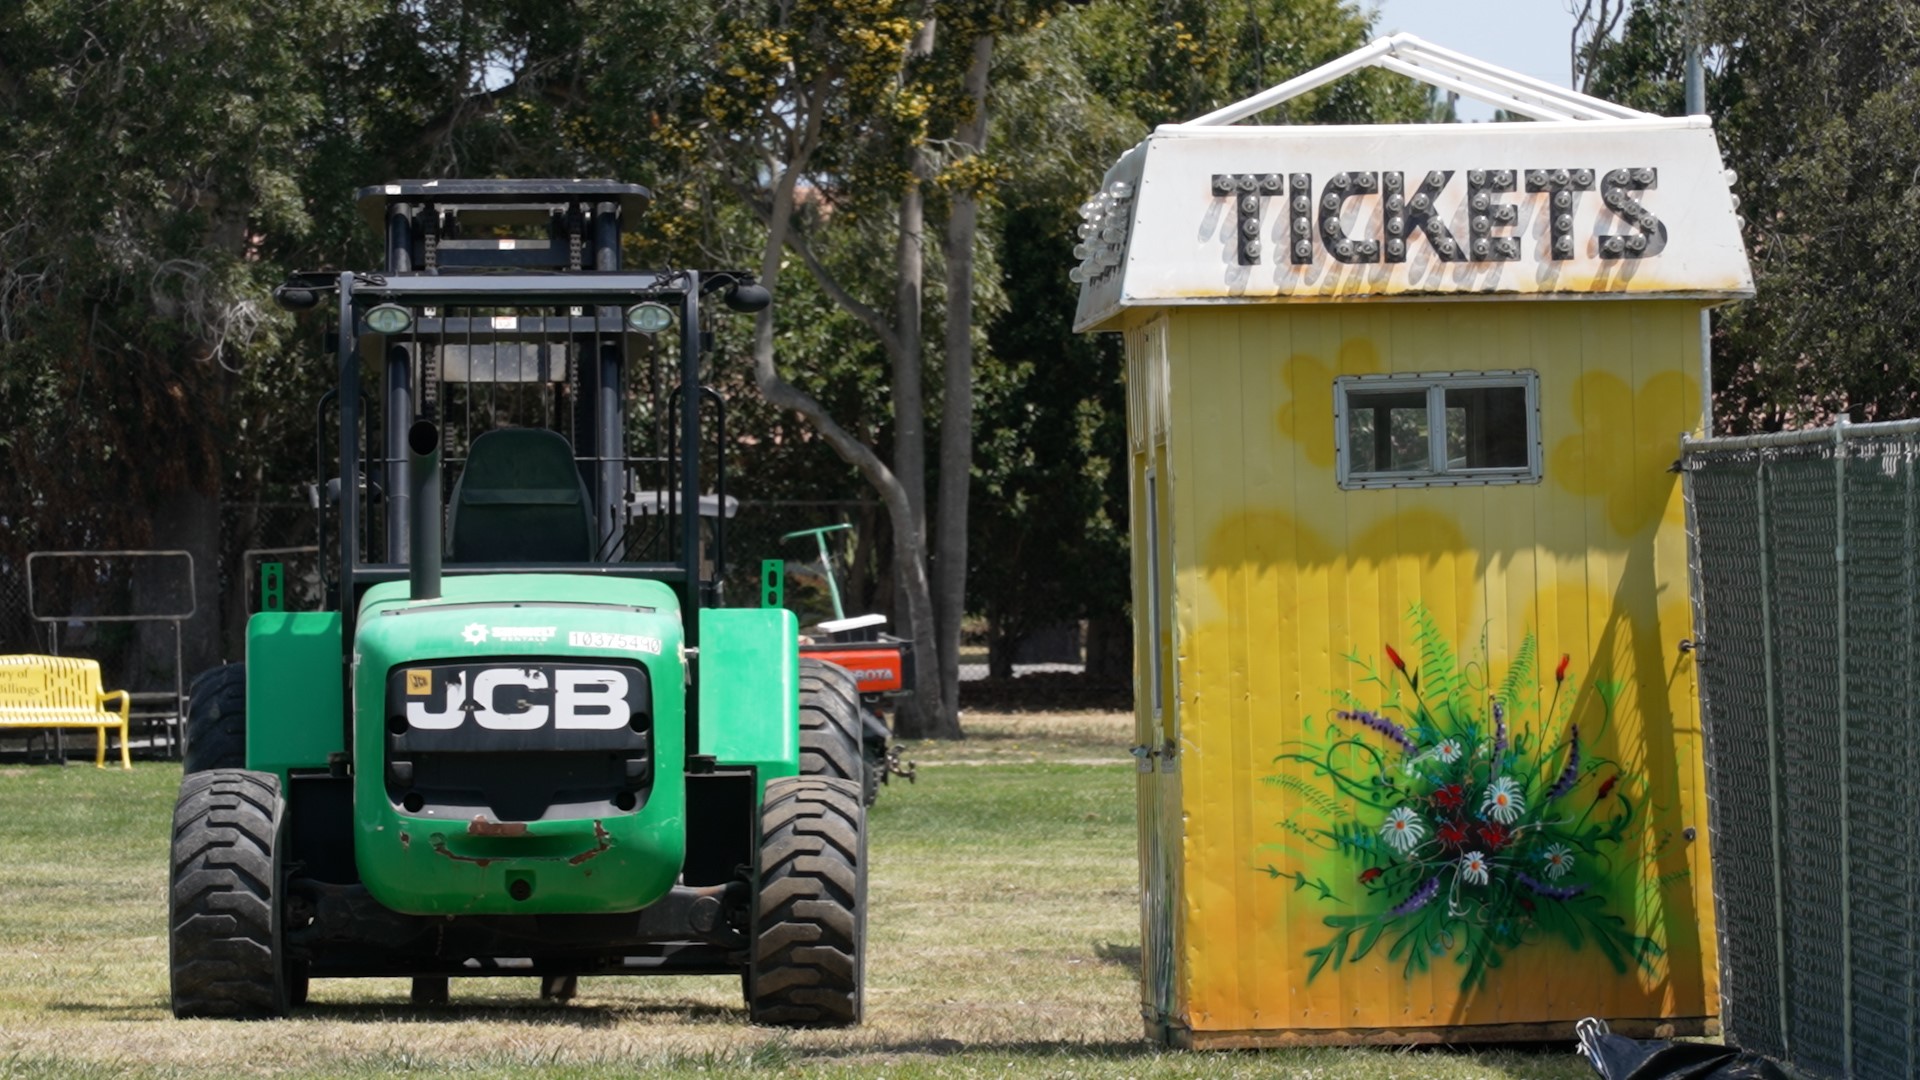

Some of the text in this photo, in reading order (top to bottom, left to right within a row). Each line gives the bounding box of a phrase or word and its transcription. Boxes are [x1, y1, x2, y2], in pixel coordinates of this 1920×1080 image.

[1211, 167, 1668, 266] TICKETS
[17, 667, 29, 679] of
[853, 669, 893, 681] BOTA
[406, 668, 631, 730] JCB
